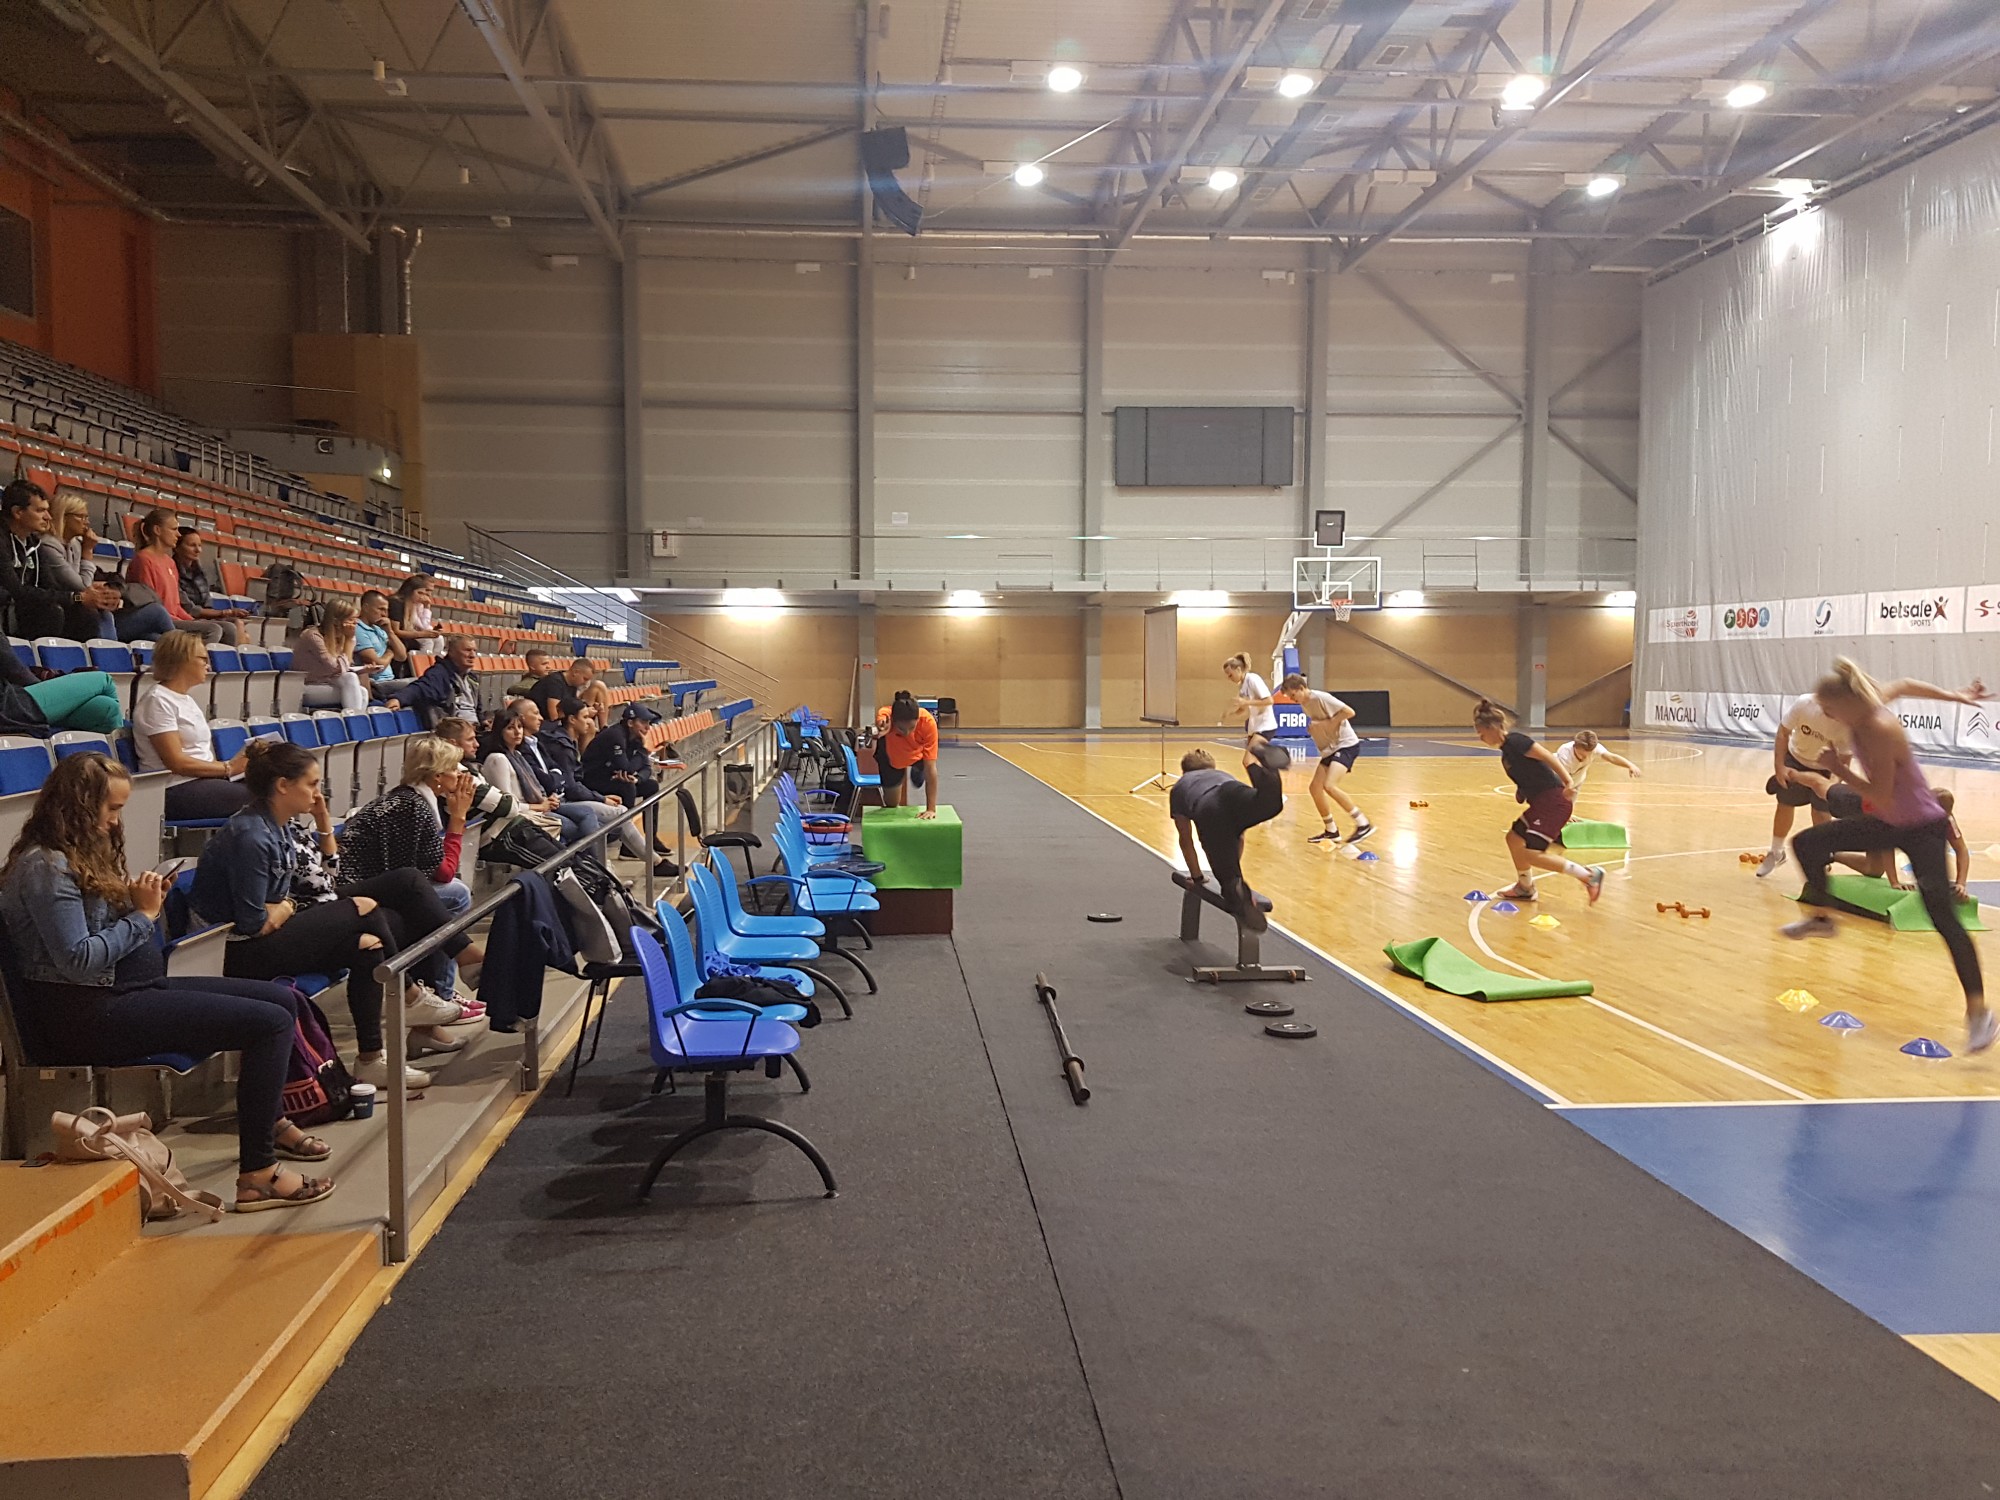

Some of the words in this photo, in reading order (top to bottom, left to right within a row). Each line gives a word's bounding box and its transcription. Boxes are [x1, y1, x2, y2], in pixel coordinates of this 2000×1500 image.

[318, 439, 329, 453] C
[1880, 599, 1932, 619] betsafe
[1910, 619, 1931, 627] SPORTS
[1279, 713, 1307, 728] FIBA
[1655, 705, 1697, 723] MANGALI
[1897, 714, 1942, 730] ASKANA
